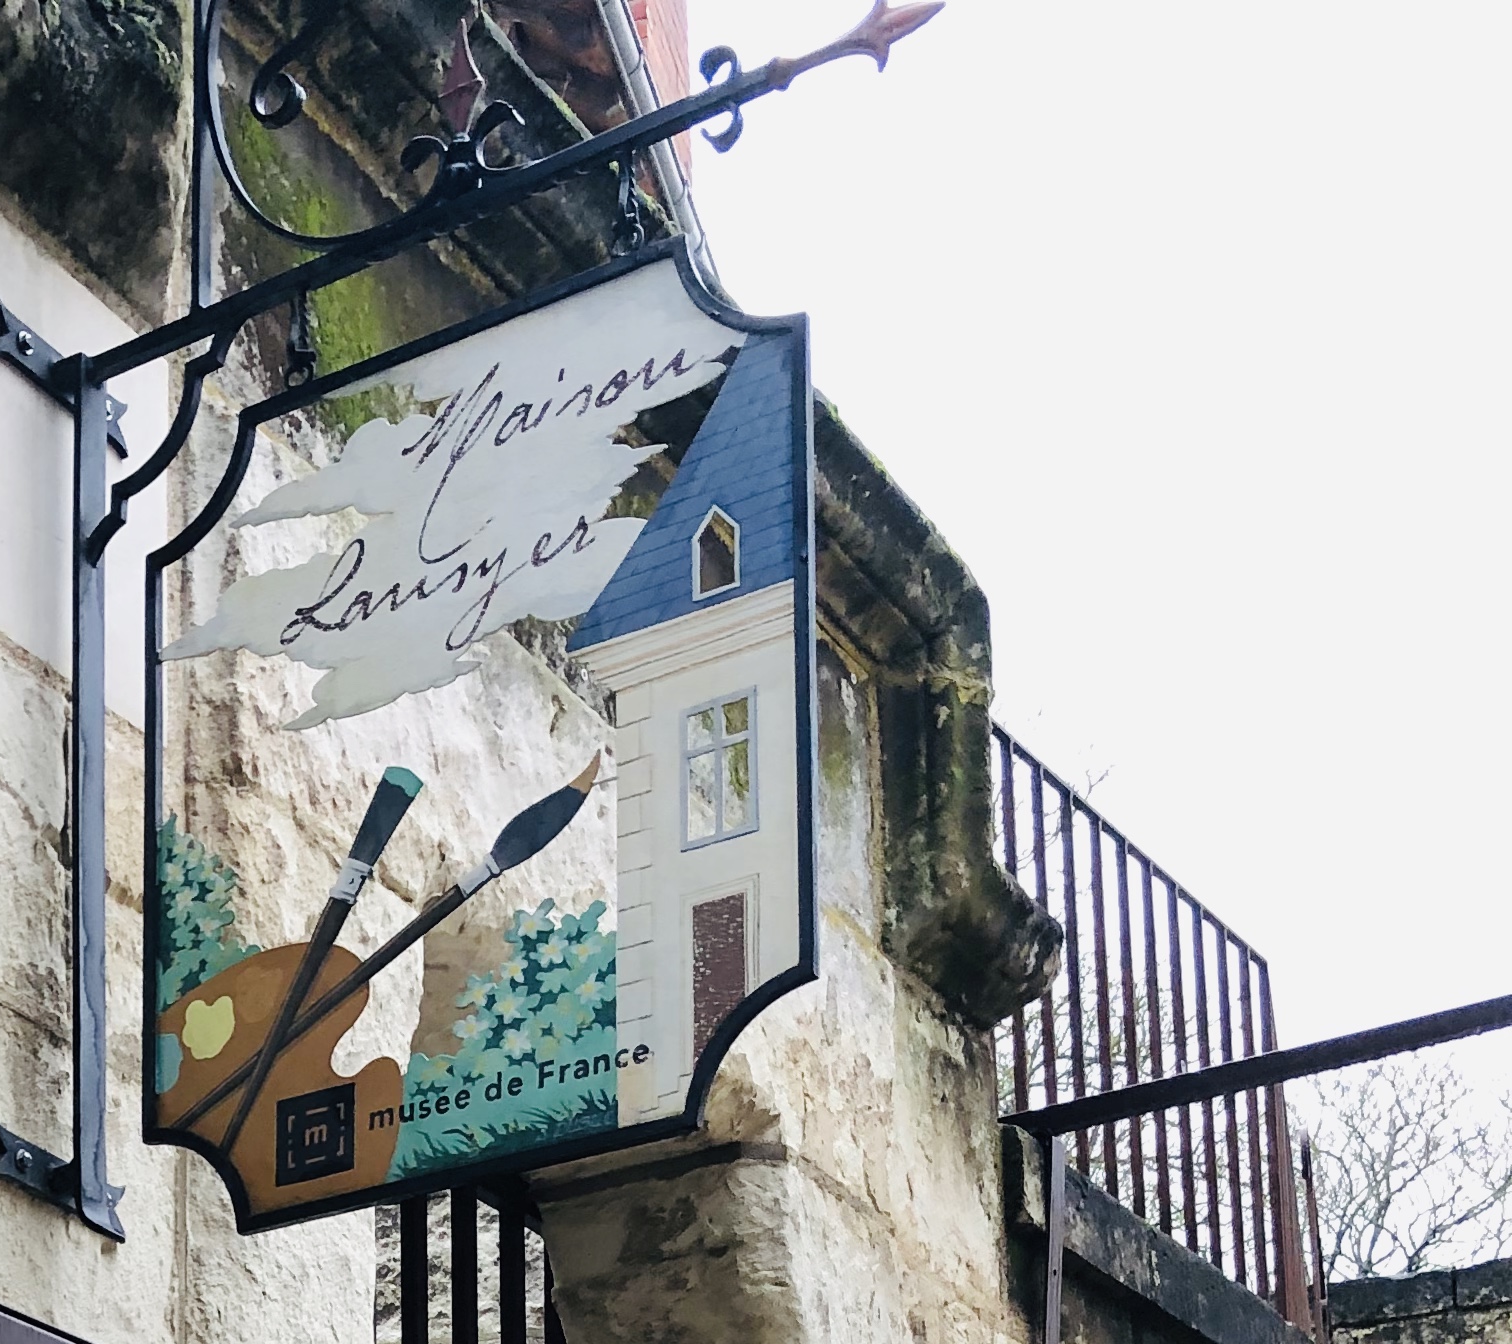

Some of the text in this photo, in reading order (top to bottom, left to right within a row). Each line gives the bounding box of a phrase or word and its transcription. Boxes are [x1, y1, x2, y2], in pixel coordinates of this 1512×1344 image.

[280, 512, 596, 651] Lansyer
[368, 1041, 650, 1131] musée de France
